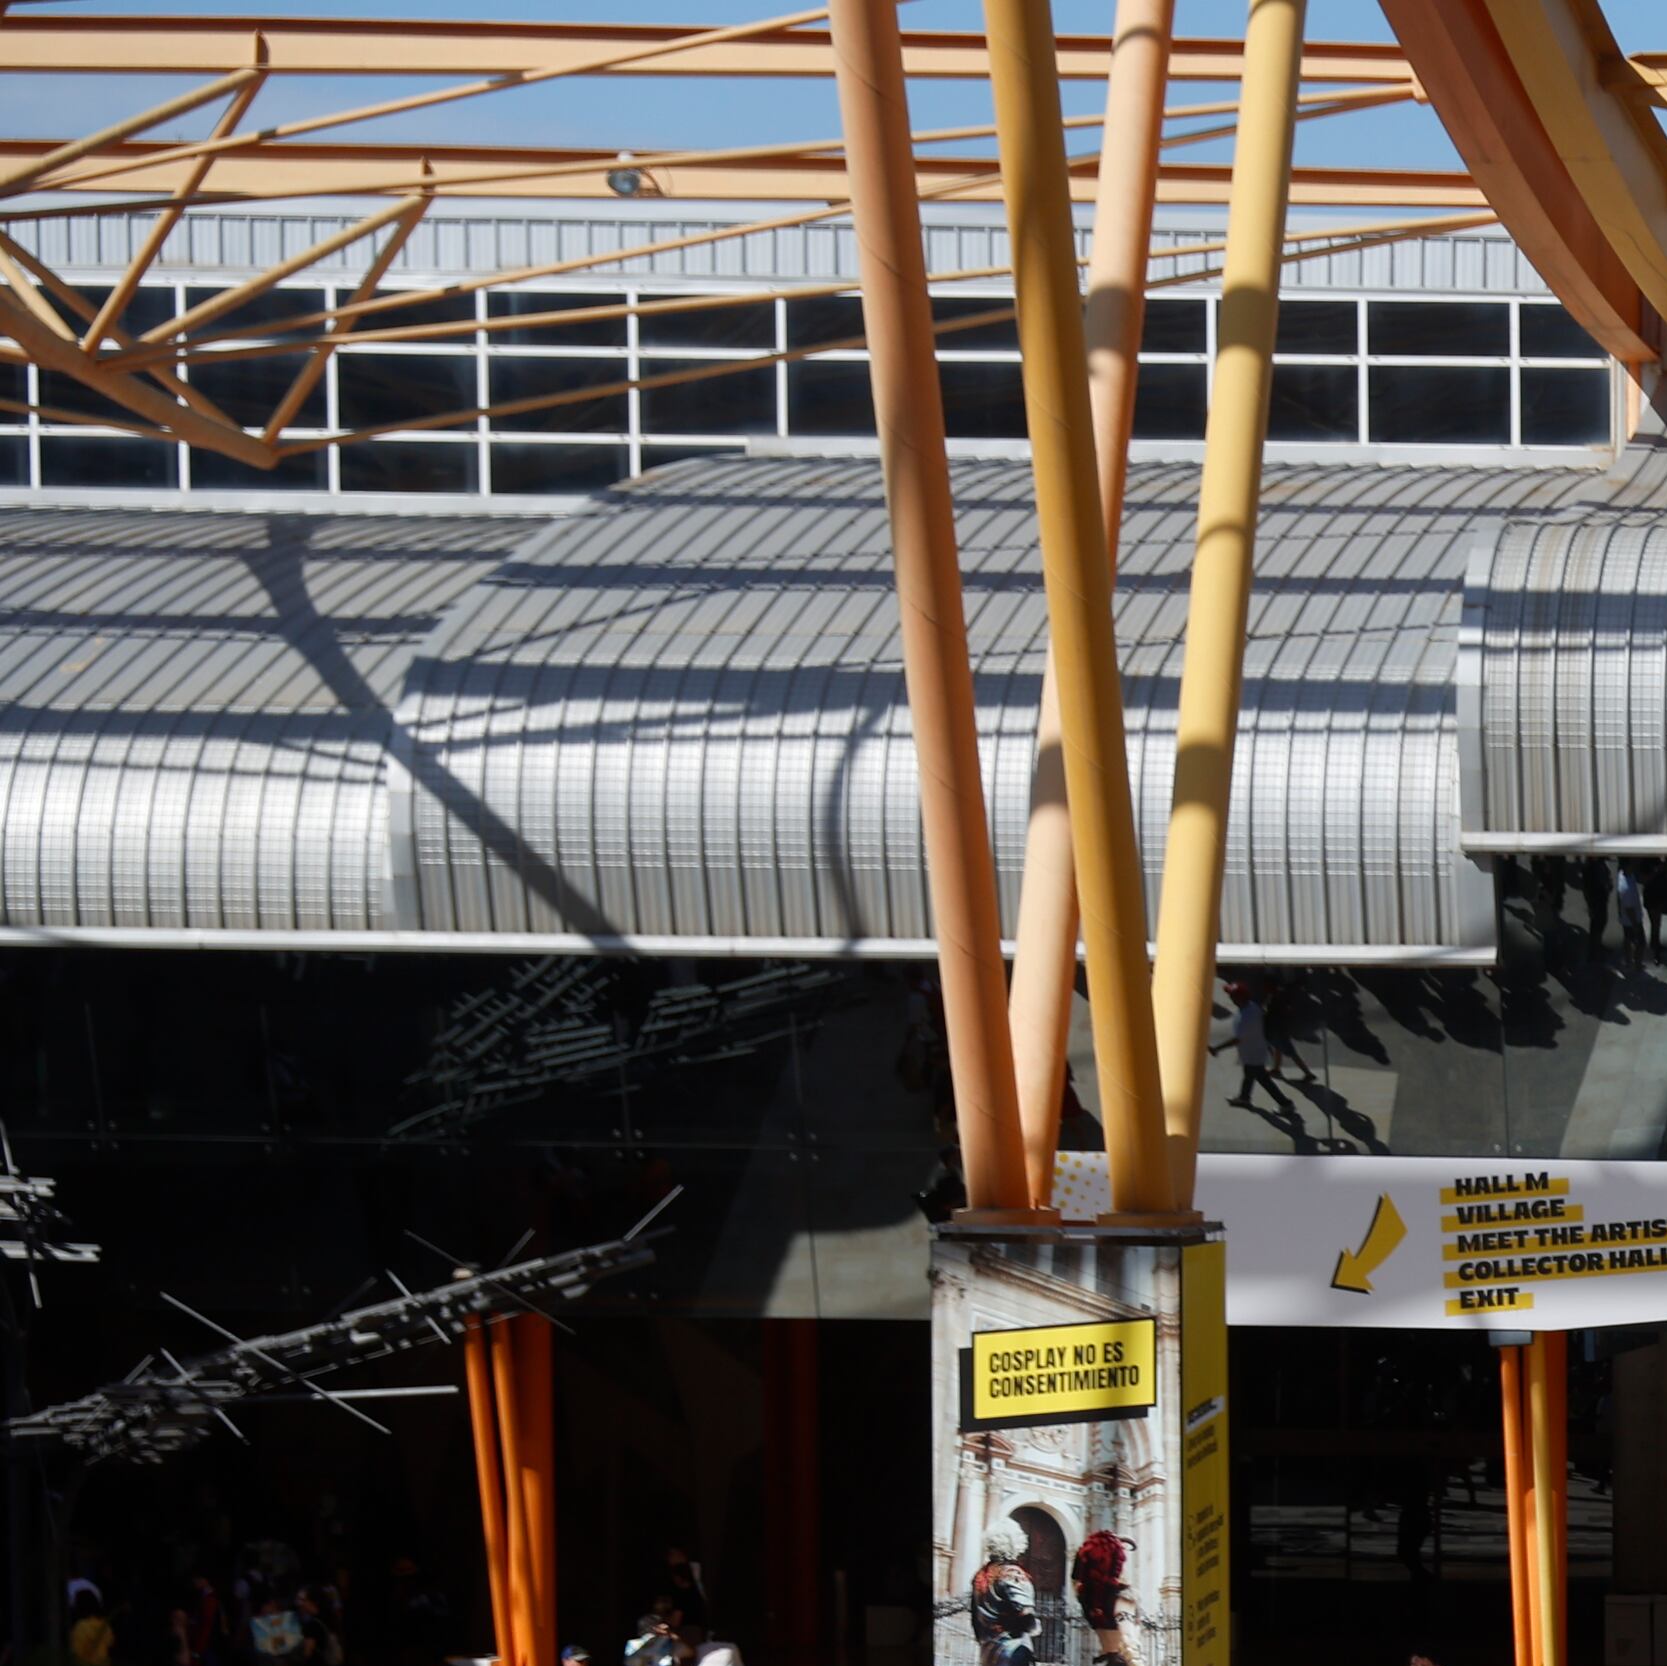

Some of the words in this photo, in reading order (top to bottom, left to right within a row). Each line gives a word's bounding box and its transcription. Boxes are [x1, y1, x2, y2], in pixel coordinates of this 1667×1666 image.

[1455, 1174, 1520, 1197] HALL
[1525, 1172, 1549, 1192] M
[1456, 1199, 1565, 1225] VILLAGE
[1457, 1229, 1528, 1253] MEET
[1534, 1225, 1585, 1247] THE
[1459, 1252, 1605, 1281] COLLECTOR
[1459, 1287, 1520, 1309] EXIT
[990, 1347, 1066, 1373] COSPLAY
[1074, 1344, 1097, 1365] NO
[1103, 1341, 1124, 1363] ES
[990, 1365, 1139, 1398] CONSENTIMIENTO
